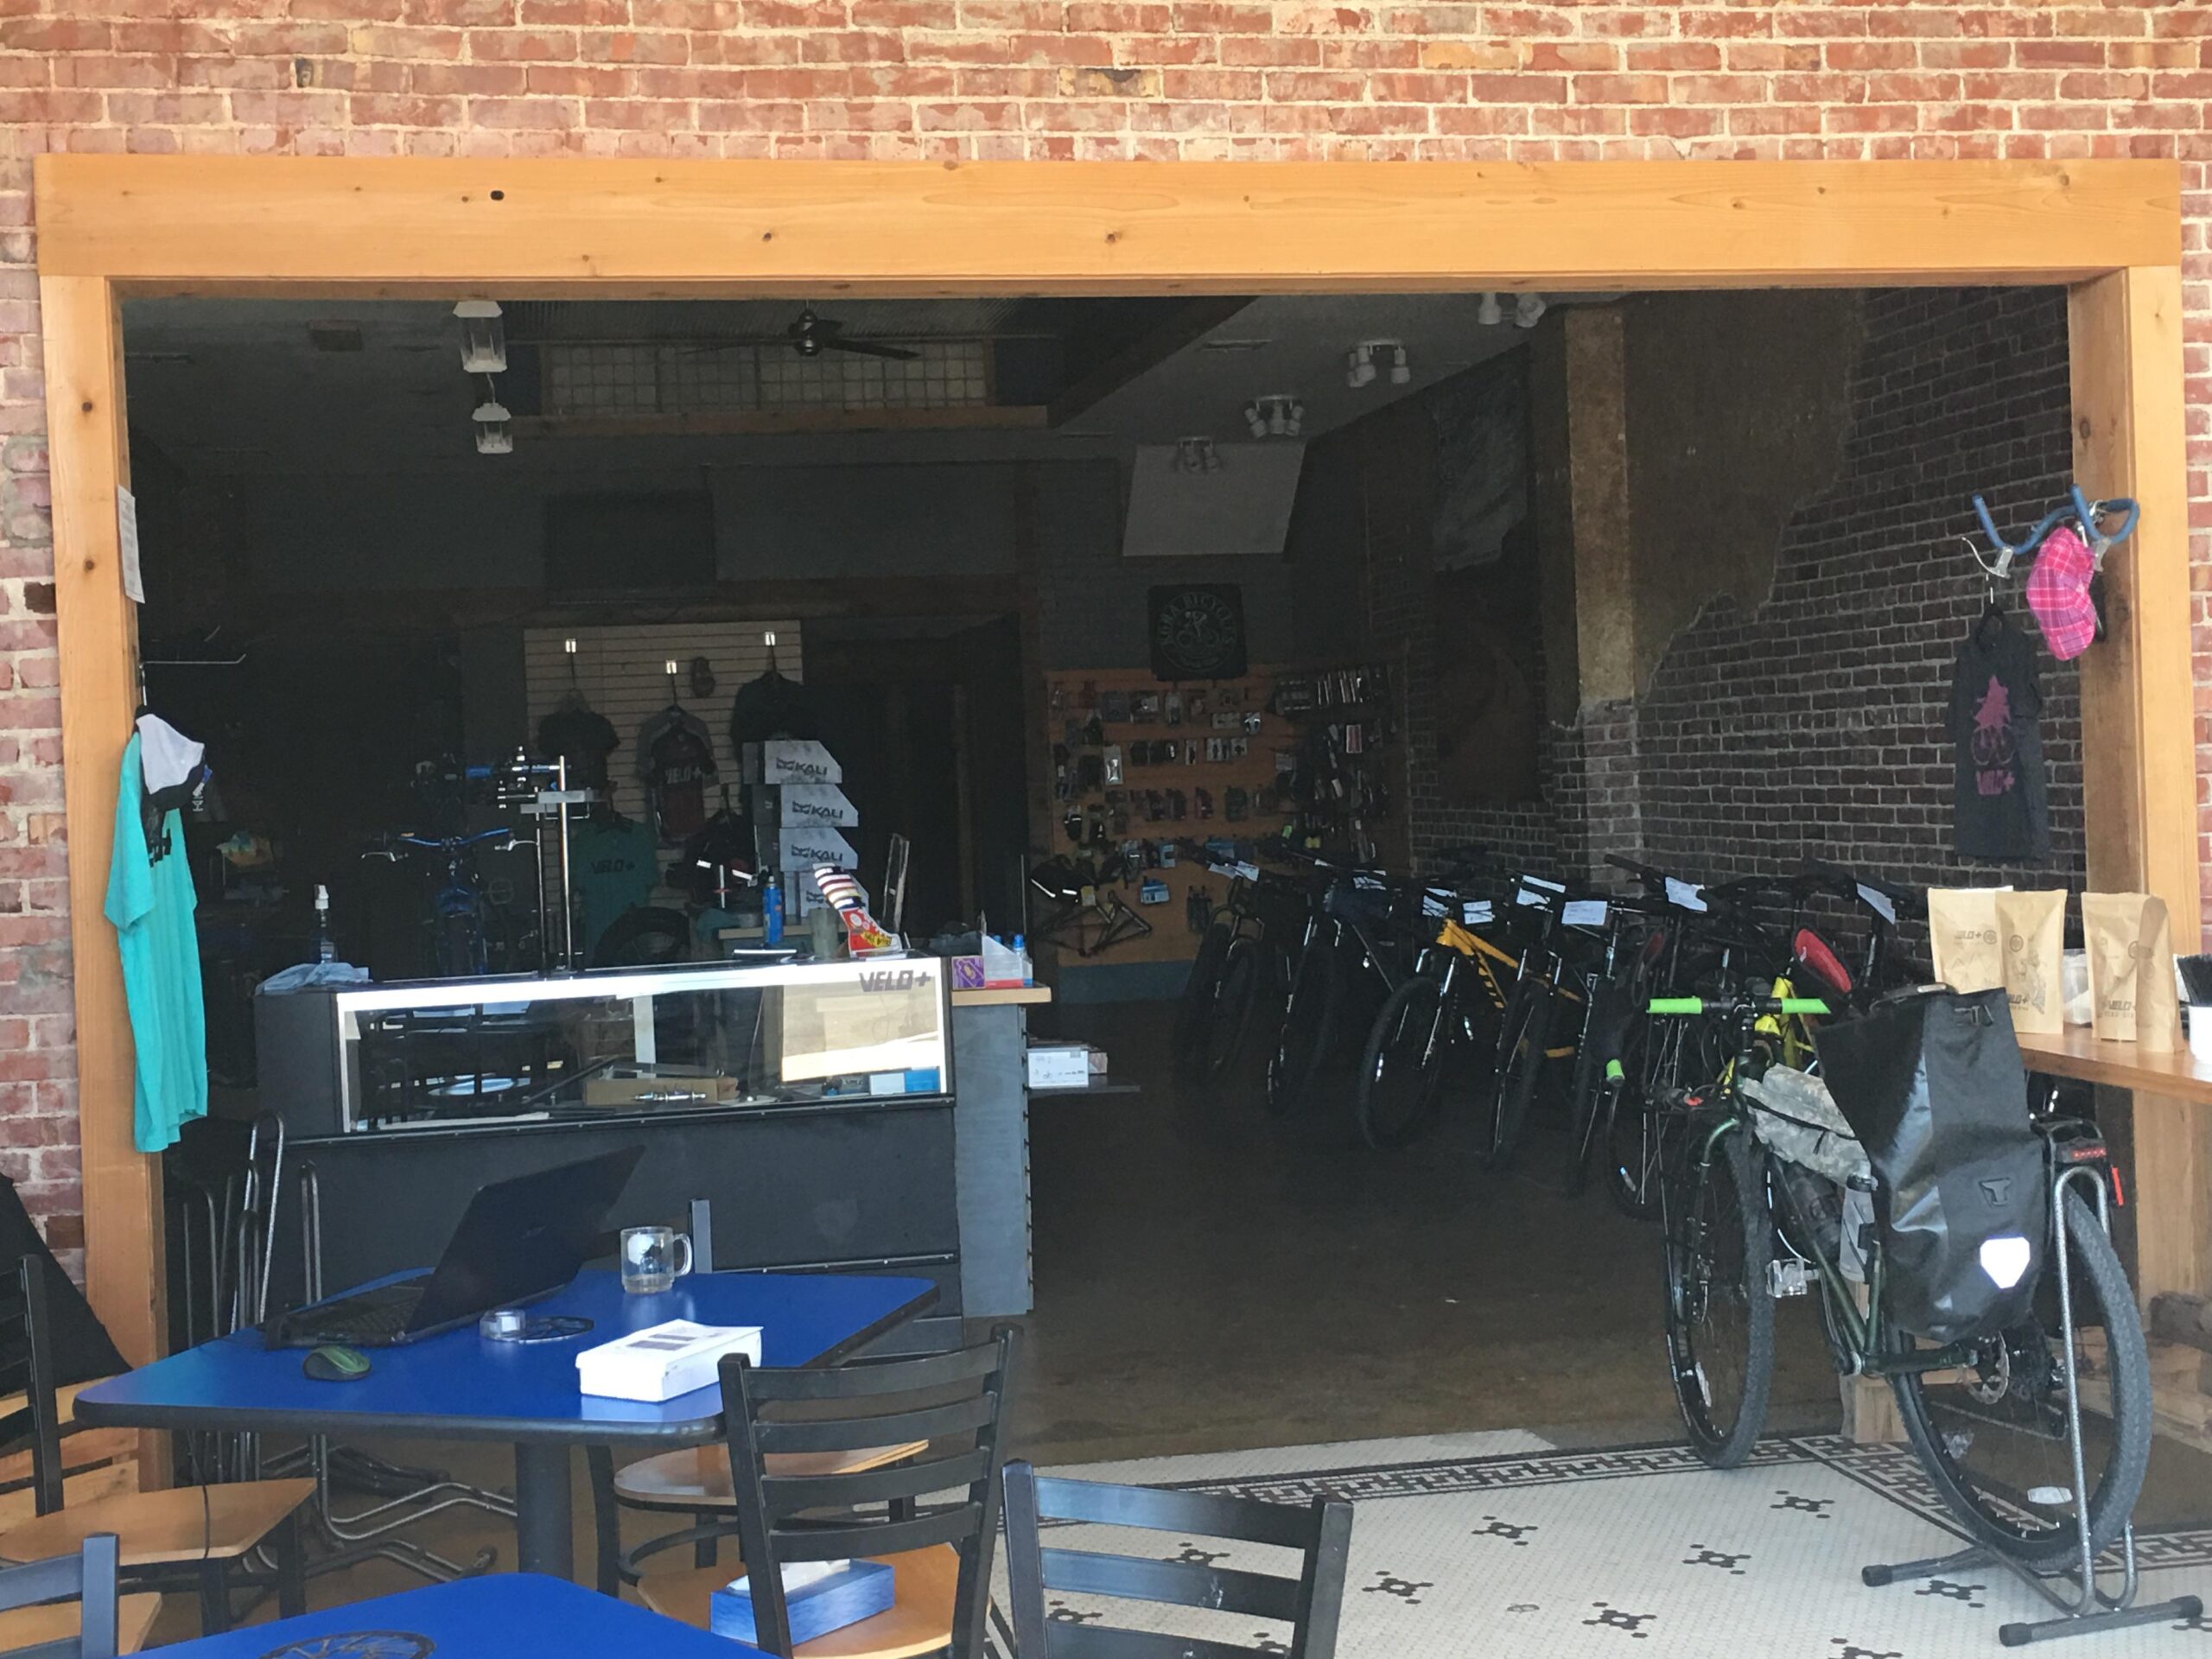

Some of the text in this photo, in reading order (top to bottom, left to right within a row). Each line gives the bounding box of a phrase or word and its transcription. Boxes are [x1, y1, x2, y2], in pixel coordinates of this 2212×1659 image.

[794, 761, 828, 776] KALI
[810, 804, 844, 820] KALI
[810, 848, 843, 862] KALI
[858, 969, 931, 993] VELO+
